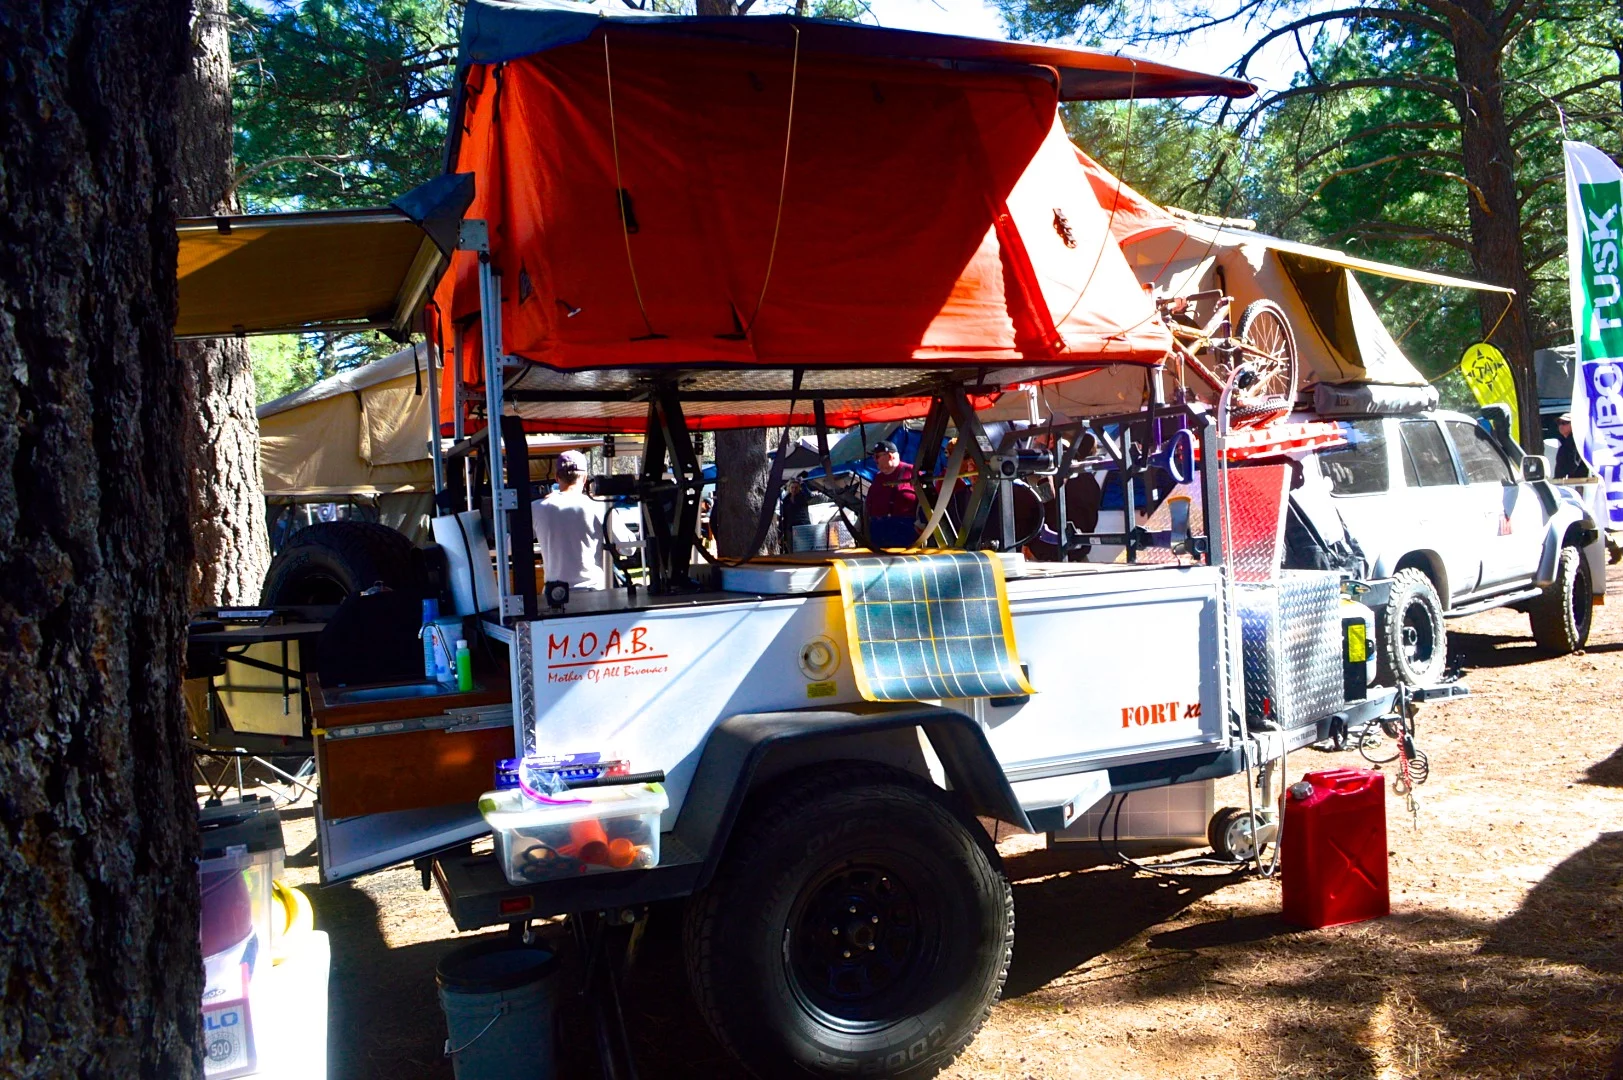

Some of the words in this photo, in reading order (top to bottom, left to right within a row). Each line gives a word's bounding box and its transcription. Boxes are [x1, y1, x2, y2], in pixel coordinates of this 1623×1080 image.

[1588, 203, 1622, 341] TUSK
[548, 627, 653, 660] M.O.A.B.
[548, 672, 584, 683] Mother
[588, 669, 600, 683] Of
[603, 667, 620, 679] All
[624, 665, 668, 677] Bivouacs
[1121, 701, 1180, 728] FORT
[1184, 703, 1202, 719] XL
[204, 1011, 239, 1030] LO
[211, 1041, 230, 1057] 500
